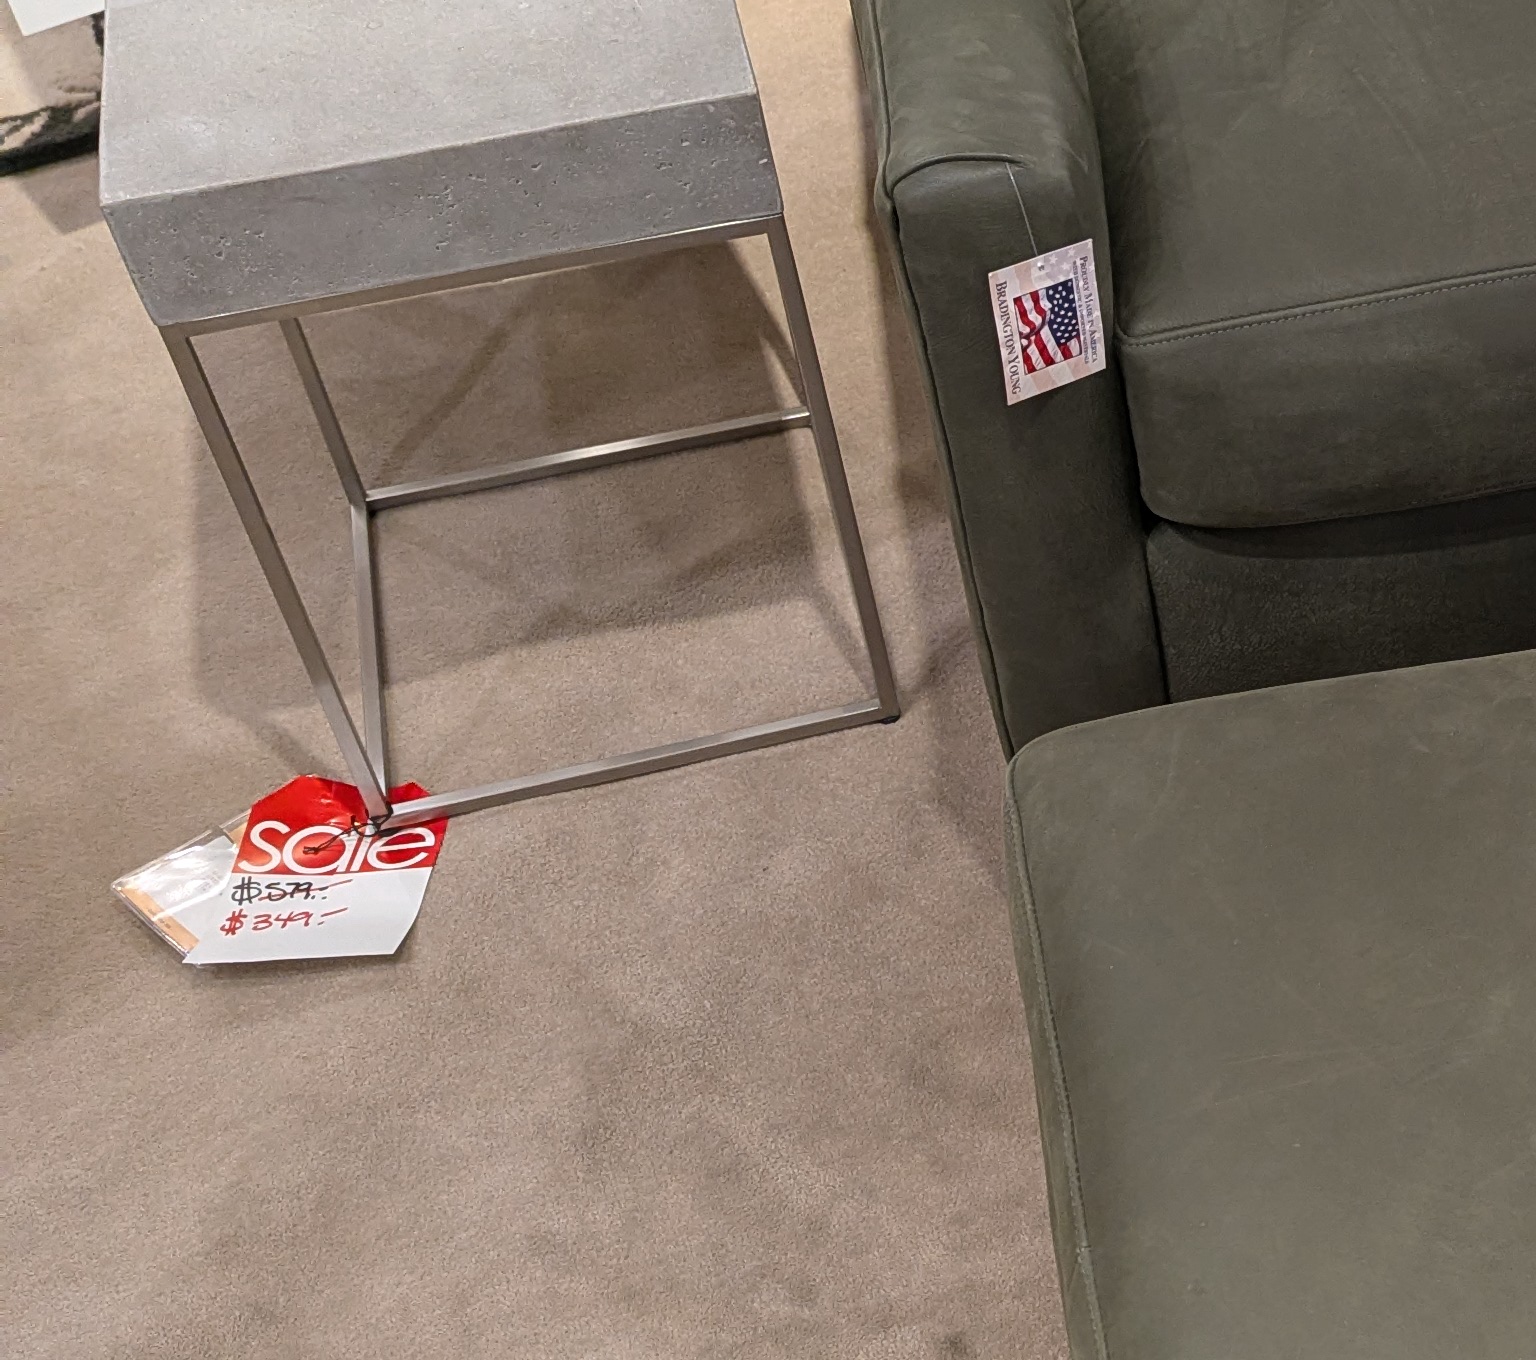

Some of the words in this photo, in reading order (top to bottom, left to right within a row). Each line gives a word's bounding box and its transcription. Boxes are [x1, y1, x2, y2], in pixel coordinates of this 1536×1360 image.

[996, 280, 1016, 356] BRADINGTON
[1008, 355, 1022, 395] YOUNG
[1084, 293, 1094, 318] MADE
[1089, 330, 1098, 363] AMERICA
[238, 820, 435, 874] sale
